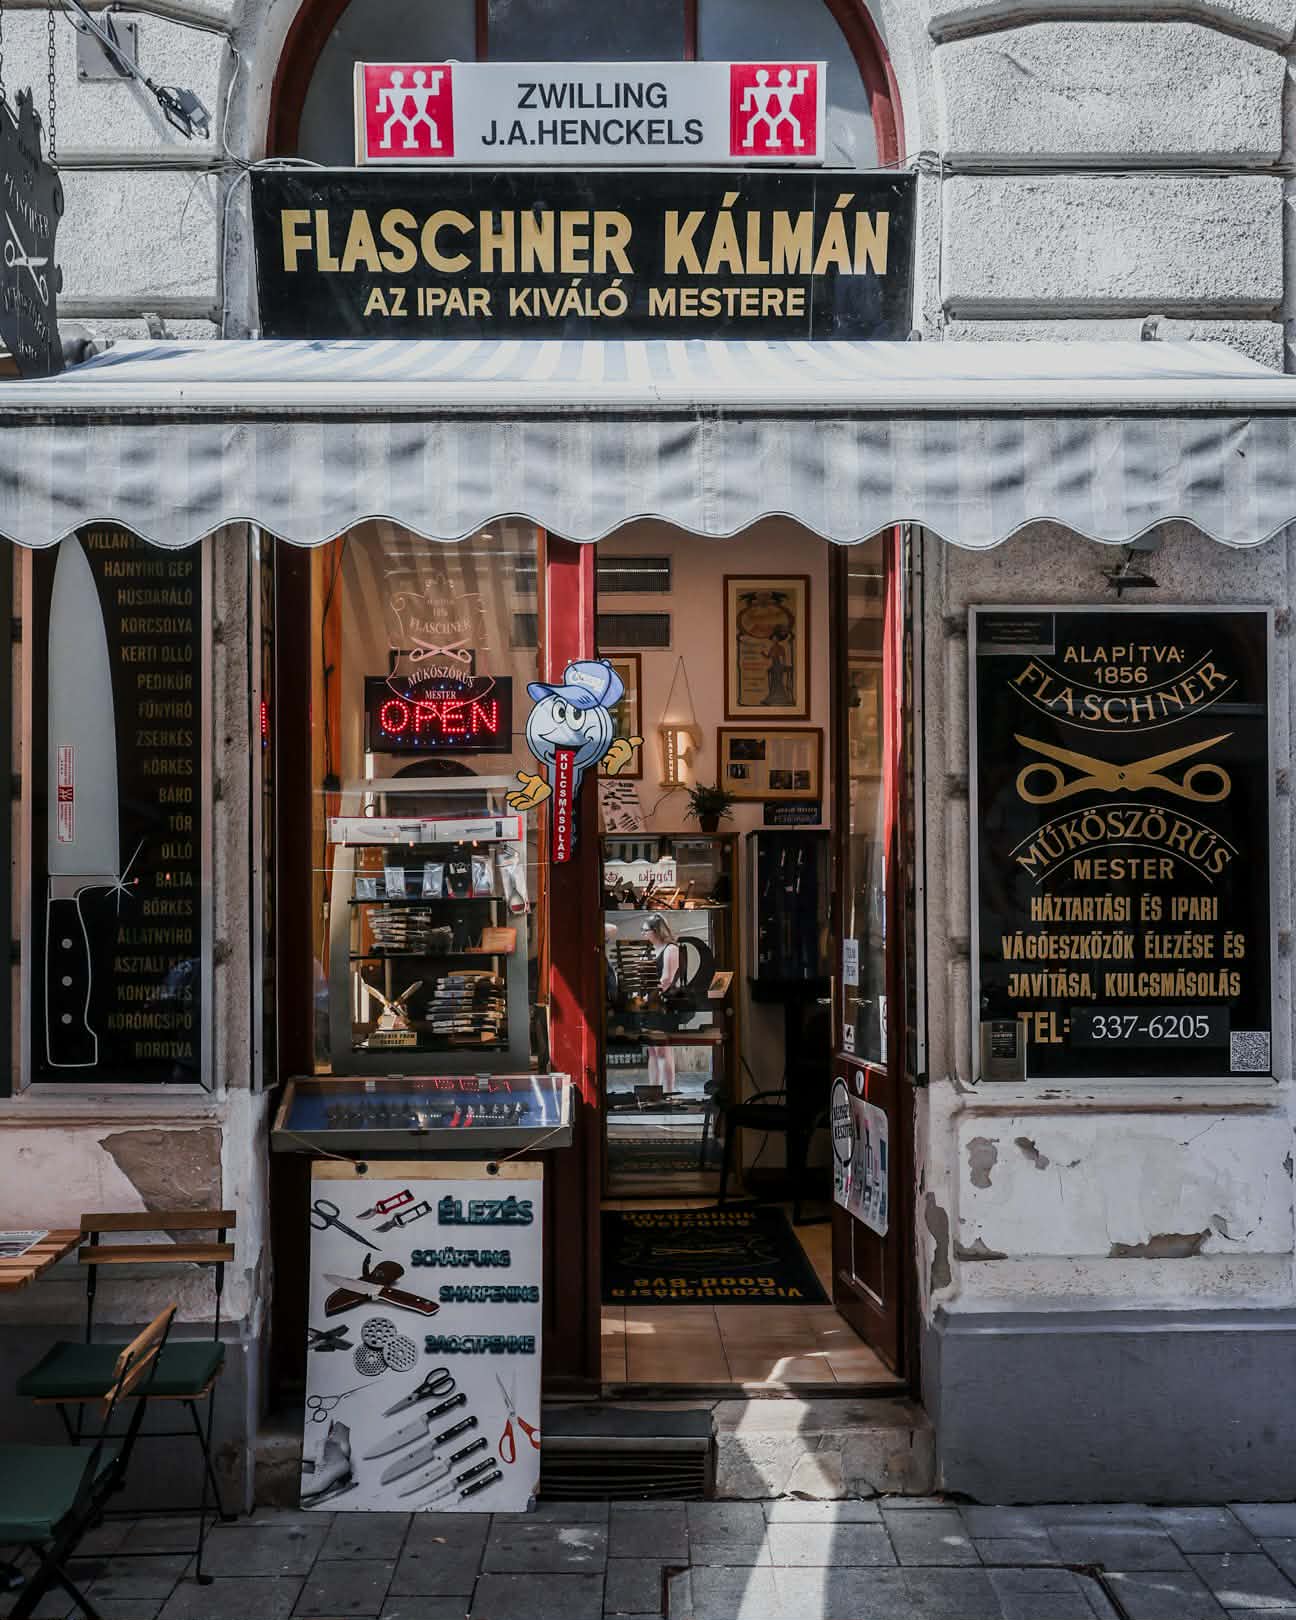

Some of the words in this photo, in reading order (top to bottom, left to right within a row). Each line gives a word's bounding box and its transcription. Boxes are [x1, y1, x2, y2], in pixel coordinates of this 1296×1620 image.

[517, 82, 668, 109] ZWILLING
[482, 119, 704, 145] J.A.HENCKELS
[281, 208, 634, 274] FLASCHNER
[664, 191, 890, 275] KÁLMÁN
[363, 287, 408, 316] AZ
[417, 287, 492, 316] IPAR
[509, 278, 628, 317] KIVÁLÓ
[649, 287, 805, 317] MESTERE
[121, 646, 158, 662] KERTI
[1063, 643, 1186, 664] ALAPÍTVA:
[1095, 667, 1148, 684] 1856
[425, 690, 457, 699] MESTER
[1014, 661, 1228, 724] FLASCHNER
[381, 700, 496, 733] OPEN
[1015, 809, 1232, 877] MŰKÖSZÖRŰS
[1074, 858, 1174, 880] MESTER
[1031, 893, 1131, 921] HÁZTARTÁSI
[1140, 893, 1162, 921] ÉS
[1171, 896, 1218, 921] IPARI
[1002, 931, 1134, 960] VÁGÓESZKÖZÖK
[1145, 931, 1214, 959] ÉLEZÉSE
[1223, 931, 1245, 958] ÉS
[1007, 969, 1097, 1000] JAVÍTÁSA,
[1105, 969, 1240, 997] KULCSMÁSOLÁS
[1017, 1011, 1071, 1044] TEL:
[1091, 1015, 1210, 1039] 337-6205
[438, 1195, 534, 1225] ÉLEZÉS
[411, 1247, 511, 1268] SCHÄRFUNG
[439, 1285, 540, 1303] SHARPENING
